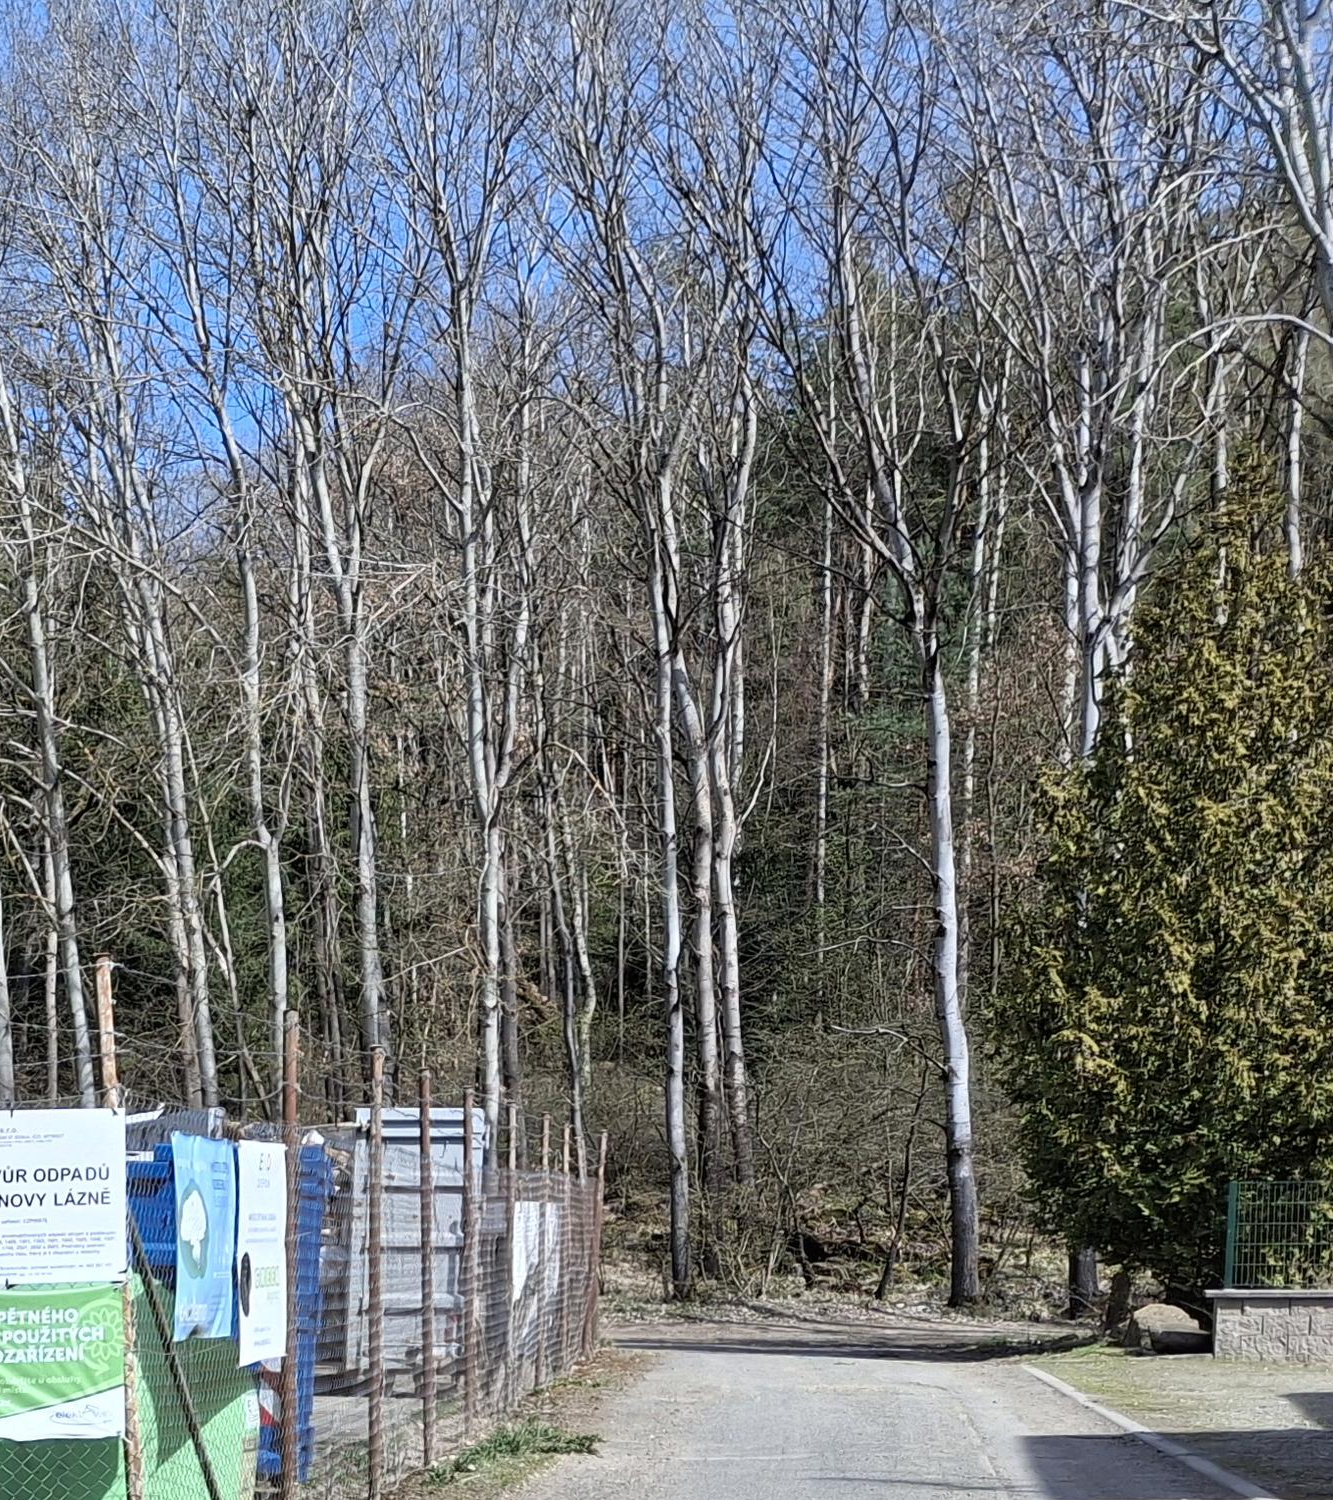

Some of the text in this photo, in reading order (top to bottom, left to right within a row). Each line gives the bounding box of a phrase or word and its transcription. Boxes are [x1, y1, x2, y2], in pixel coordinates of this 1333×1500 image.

[33, 1162, 110, 1183] ODPADŮ
[53, 1187, 111, 1206] LÁZNĚ
[2, 1323, 104, 1344] POUŽITÝCH
